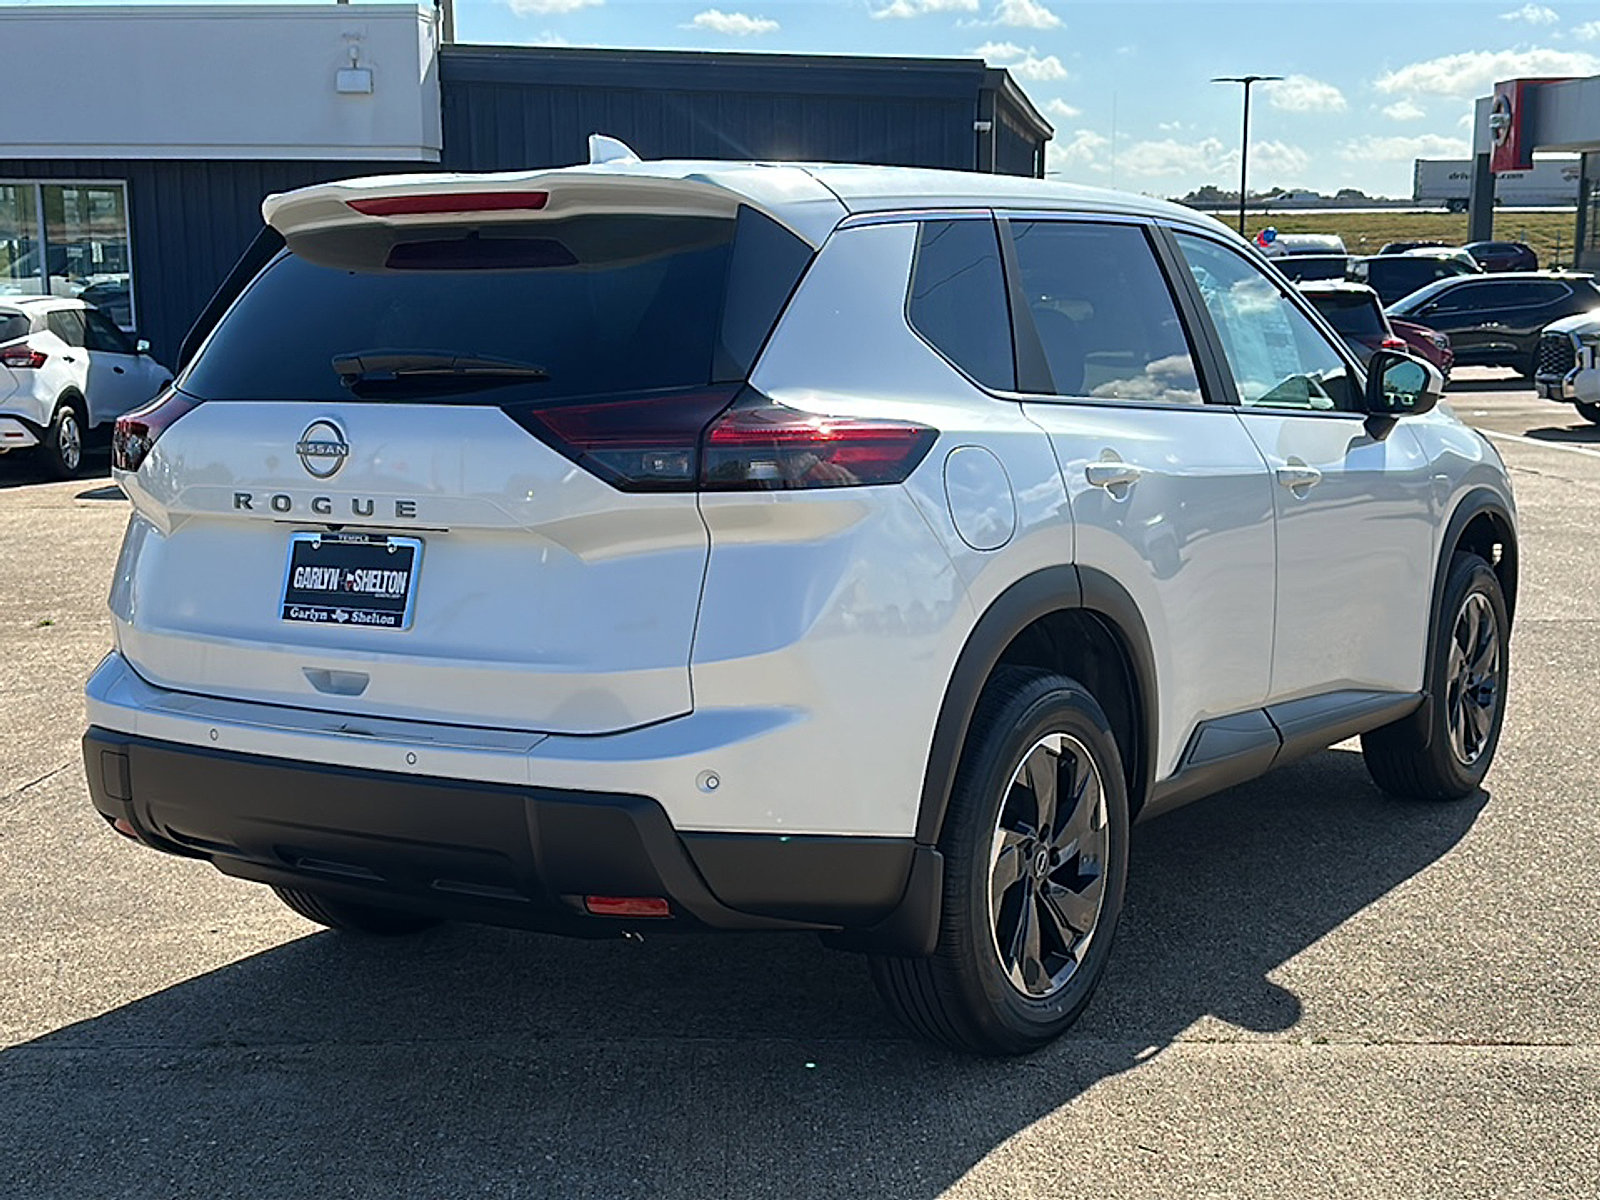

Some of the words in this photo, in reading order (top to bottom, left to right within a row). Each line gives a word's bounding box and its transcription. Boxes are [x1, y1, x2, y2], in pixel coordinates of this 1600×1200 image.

[297, 443, 346, 455] NISSAN
[233, 492, 417, 518] ROGUE
[338, 533, 370, 542] TEMPLE
[293, 566, 340, 591] GARLYN
[353, 569, 408, 594] SHELTON
[289, 606, 328, 622] Garlyn
[350, 611, 395, 625] Shelton
